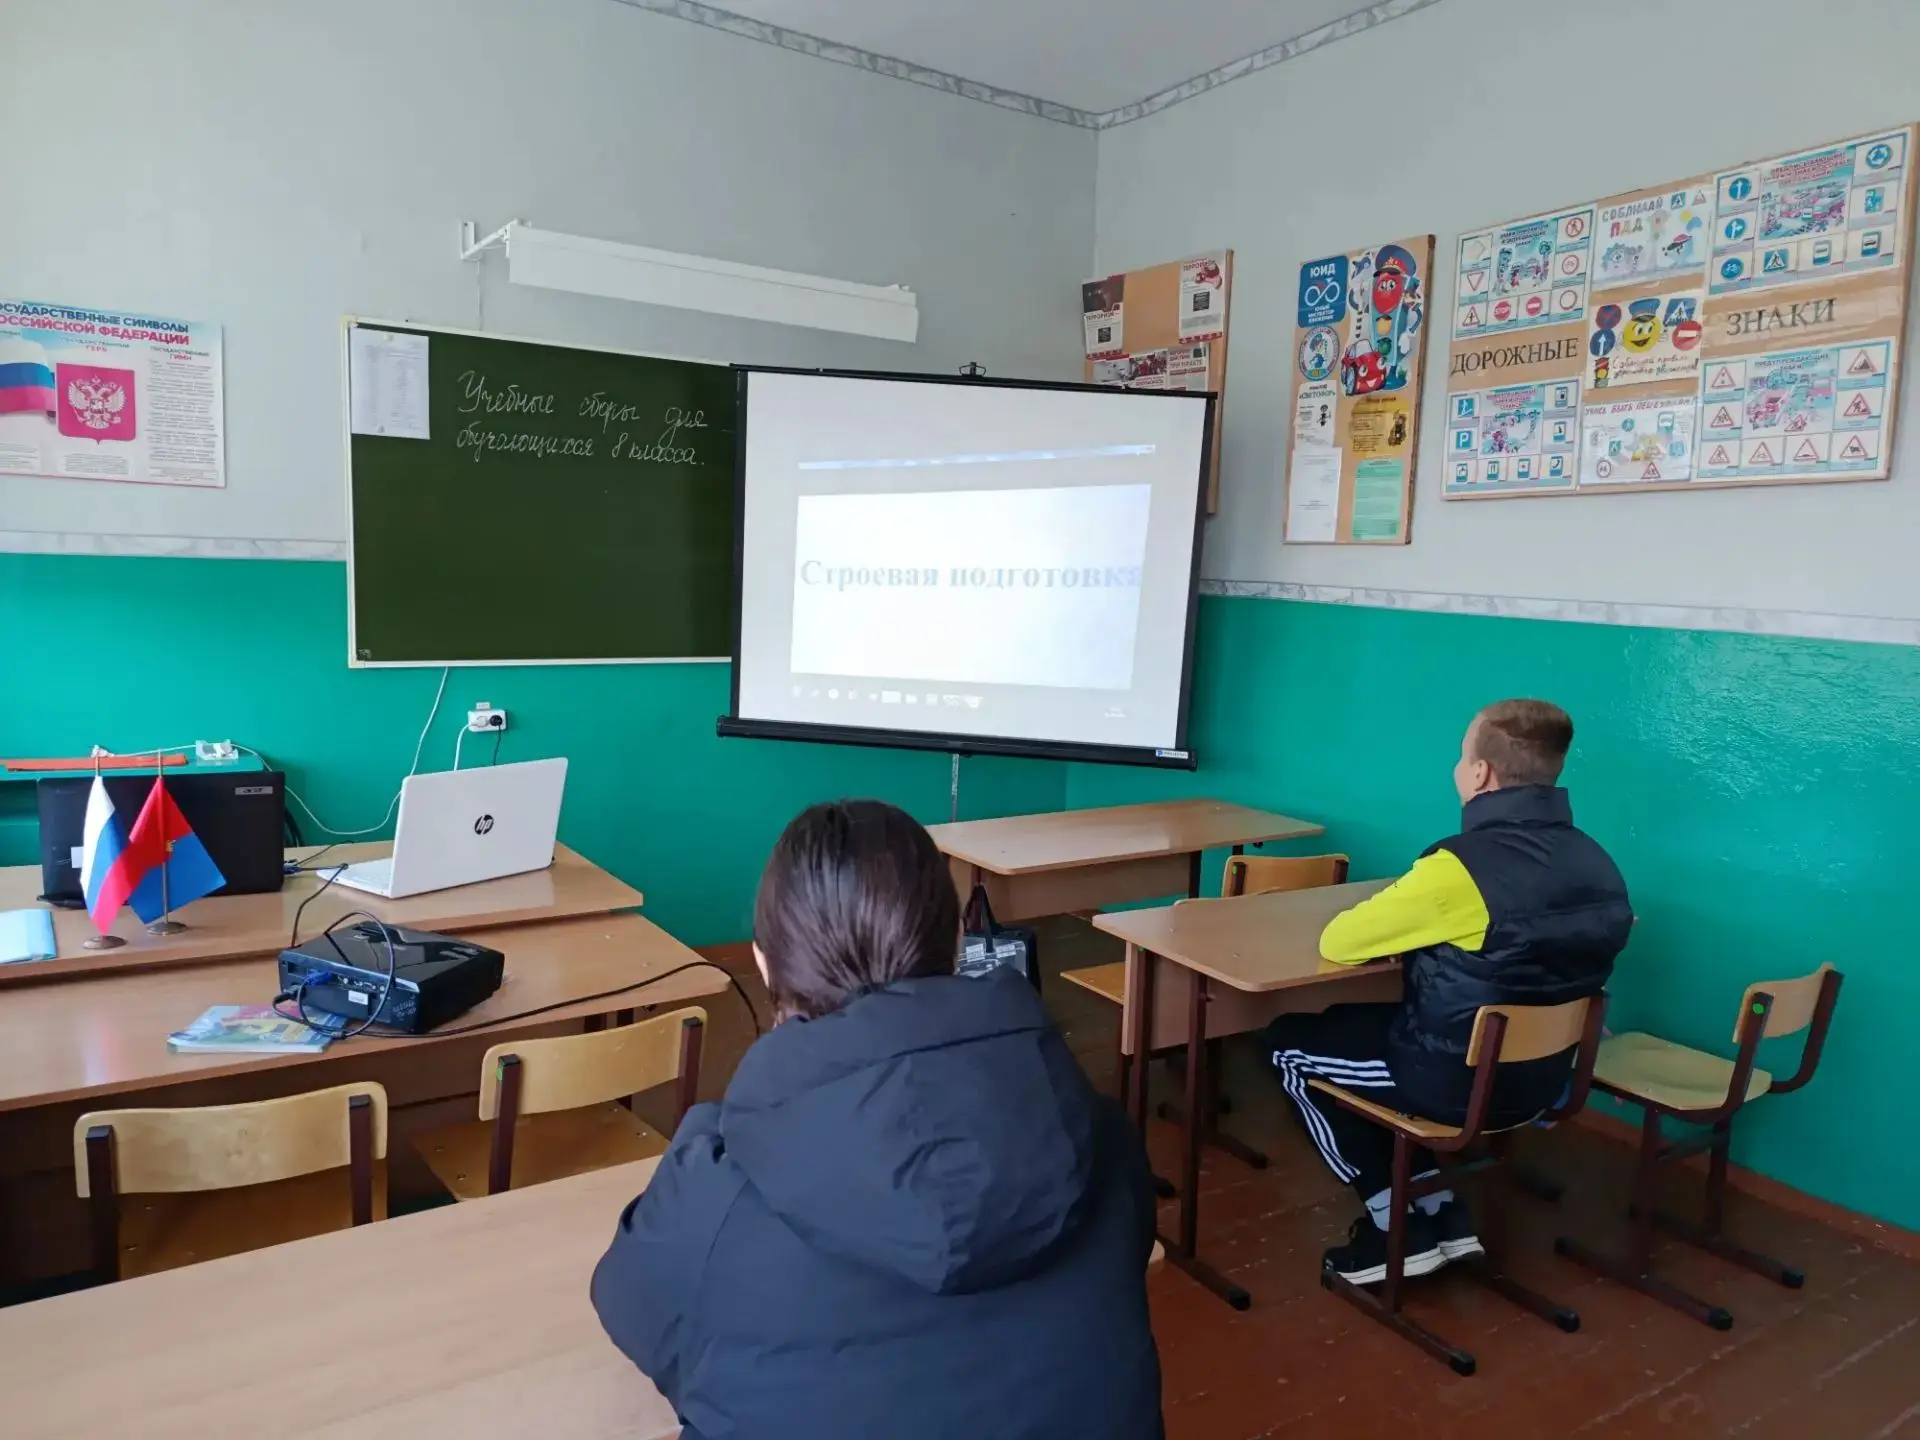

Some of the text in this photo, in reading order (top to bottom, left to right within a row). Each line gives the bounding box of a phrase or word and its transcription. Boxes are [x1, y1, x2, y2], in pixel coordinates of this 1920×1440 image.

[1610, 218, 1644, 238] ПДД
[1310, 263, 1336, 278] ЮИД
[123, 316, 189, 334] СИМВОЛЫ
[98, 326, 190, 346] ФЕДЕРАЦИИ
[1450, 297, 1837, 377] ДОРОЖНЫЕ ЗНАКИ
[457, 369, 709, 448] Учебные сборы для
[800, 560, 1142, 593] Строевая подготовка
[475, 815, 494, 835] hp
